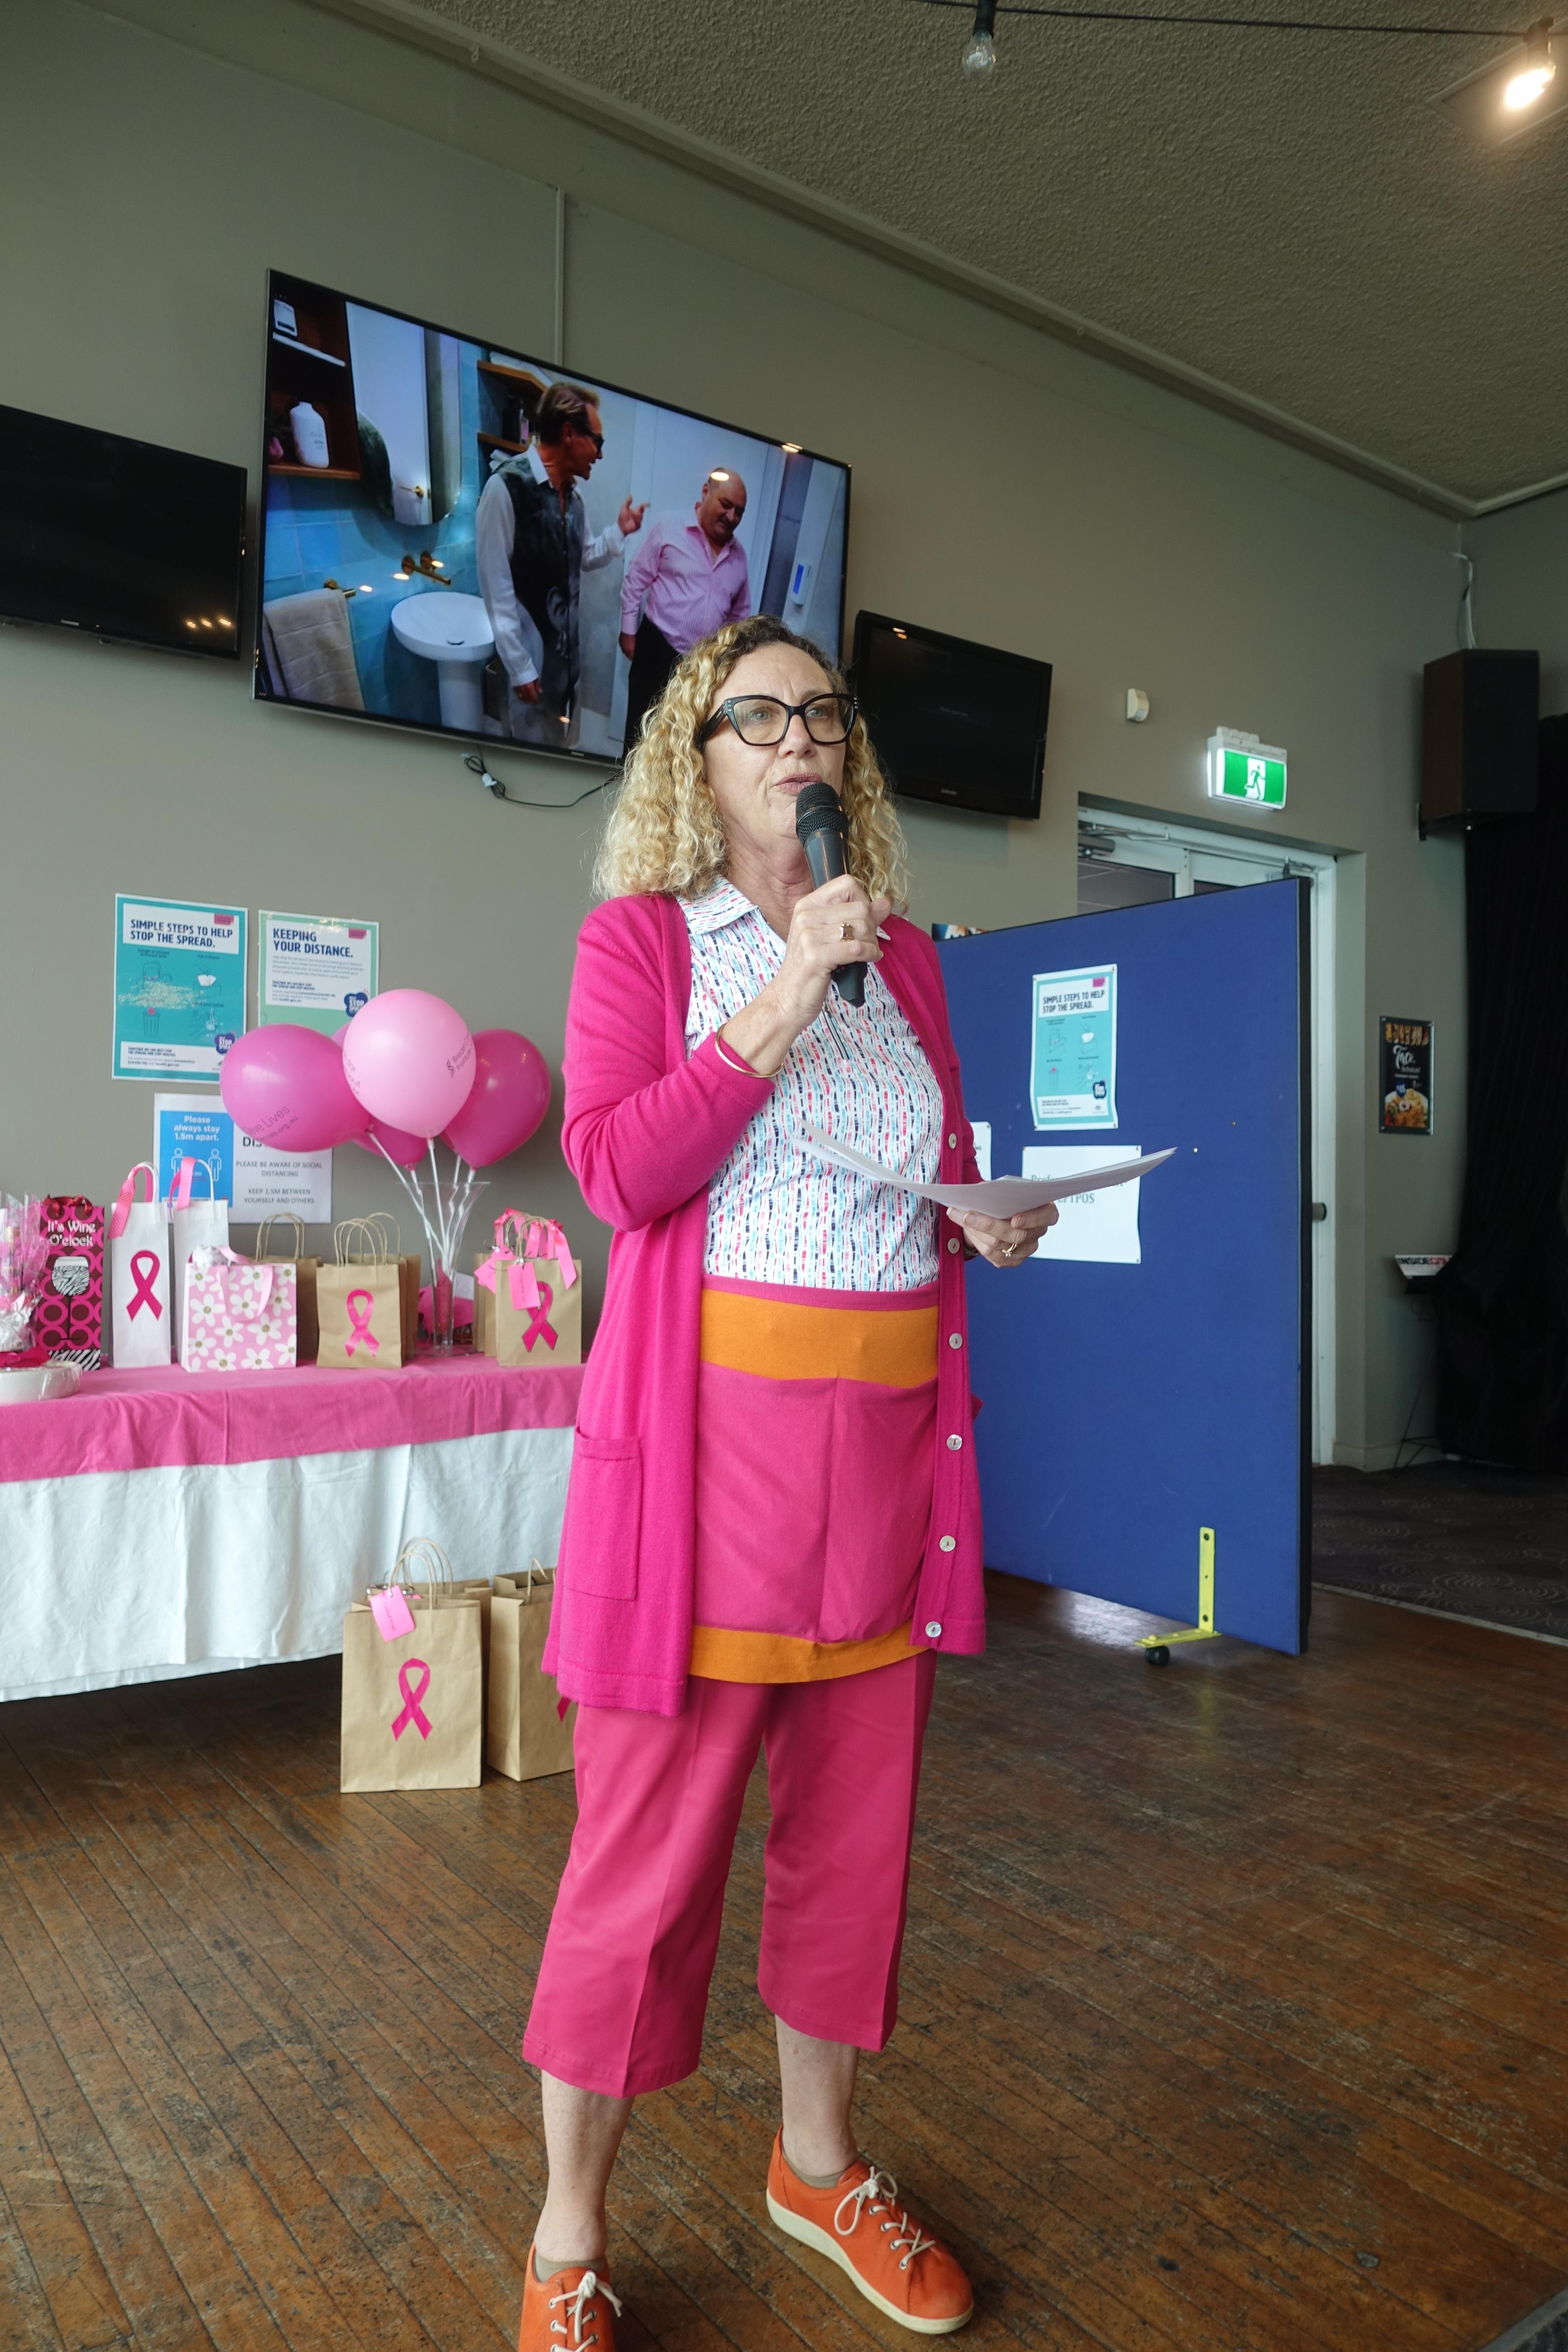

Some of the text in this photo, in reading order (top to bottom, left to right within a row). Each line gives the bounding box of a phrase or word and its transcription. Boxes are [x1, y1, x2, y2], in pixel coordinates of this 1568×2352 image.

[131, 919, 233, 938] SIMPLE STEPS TO HELP
[273, 928, 317, 942] KEEPING
[131, 931, 215, 948] STOP THE SPREAD.
[273, 940, 353, 958] YOUR DISTANCE.
[1043, 989, 1105, 1004] SIMPLE STEPS TO HELP
[1043, 1001, 1093, 1014] STOP THE SPREAD.
[184, 1115, 211, 1124] Please
[261, 1106, 291, 1128] Lives
[174, 1124, 220, 1134] always stay
[175, 1132, 219, 1142] 1.5m apart.
[48, 1219, 96, 1234] It's Wine
[50, 1234, 93, 1247] O'clock
